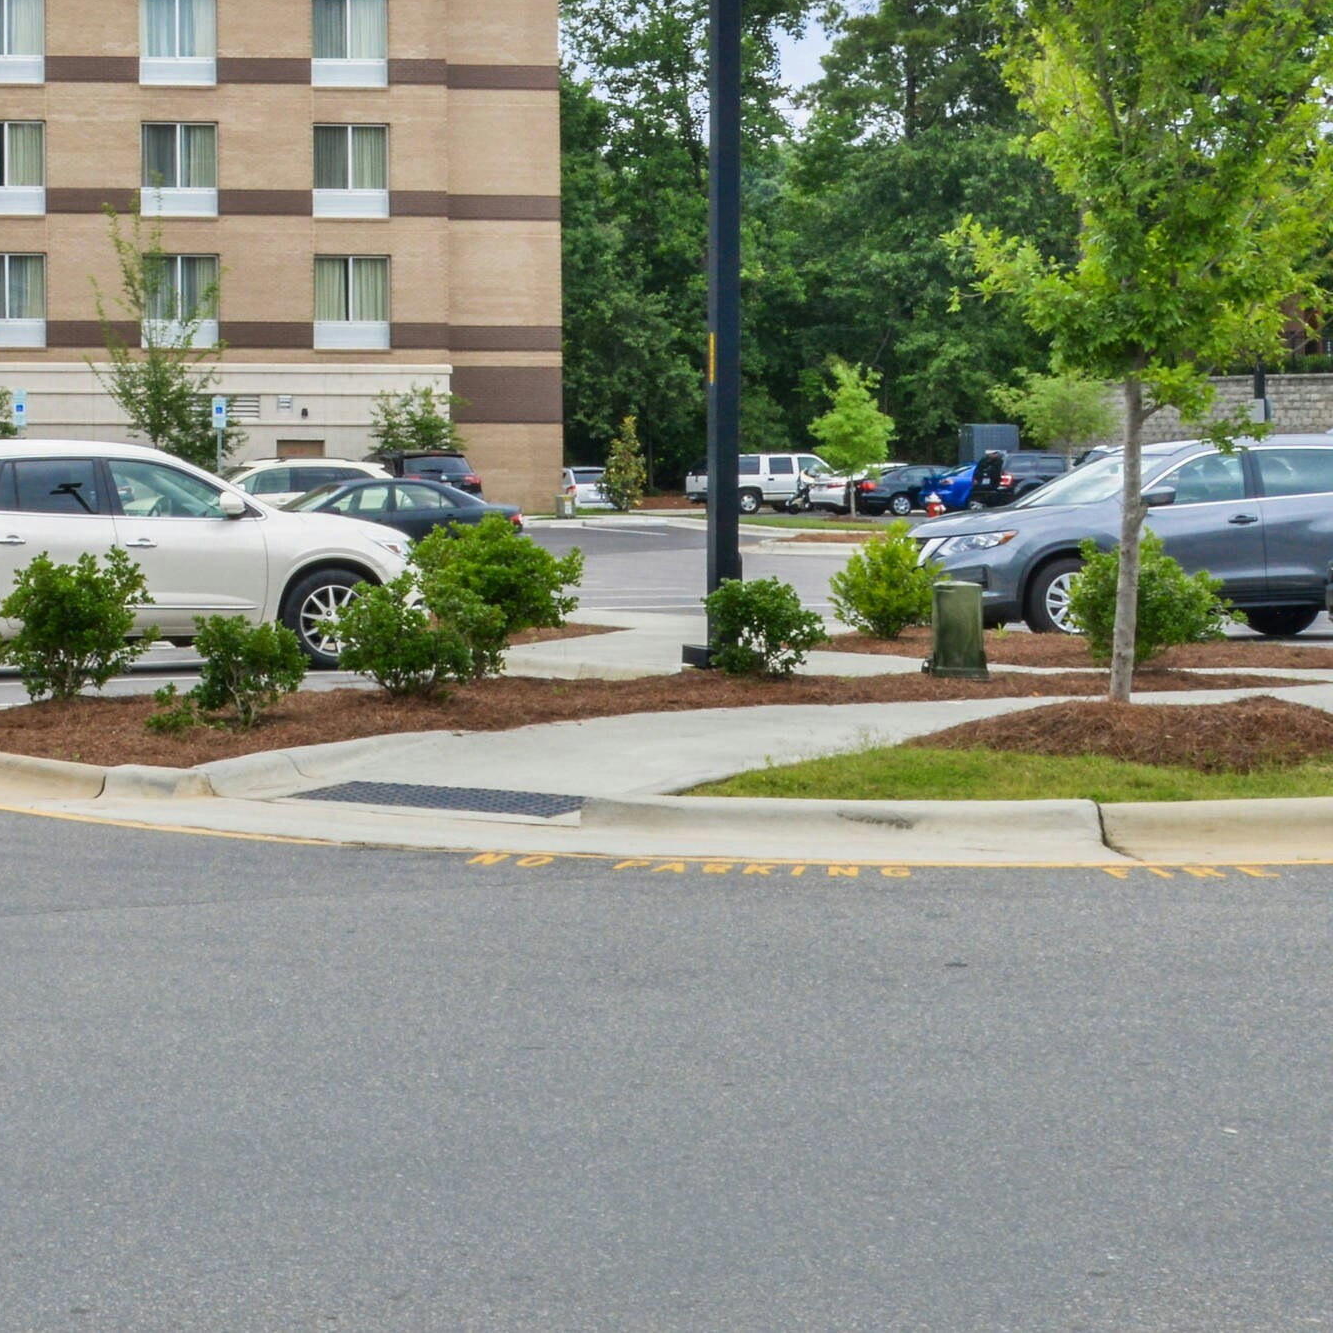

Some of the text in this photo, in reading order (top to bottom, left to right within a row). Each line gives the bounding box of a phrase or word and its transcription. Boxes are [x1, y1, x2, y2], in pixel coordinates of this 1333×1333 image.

[467, 852, 1281, 879] NO PARKING FIRE
